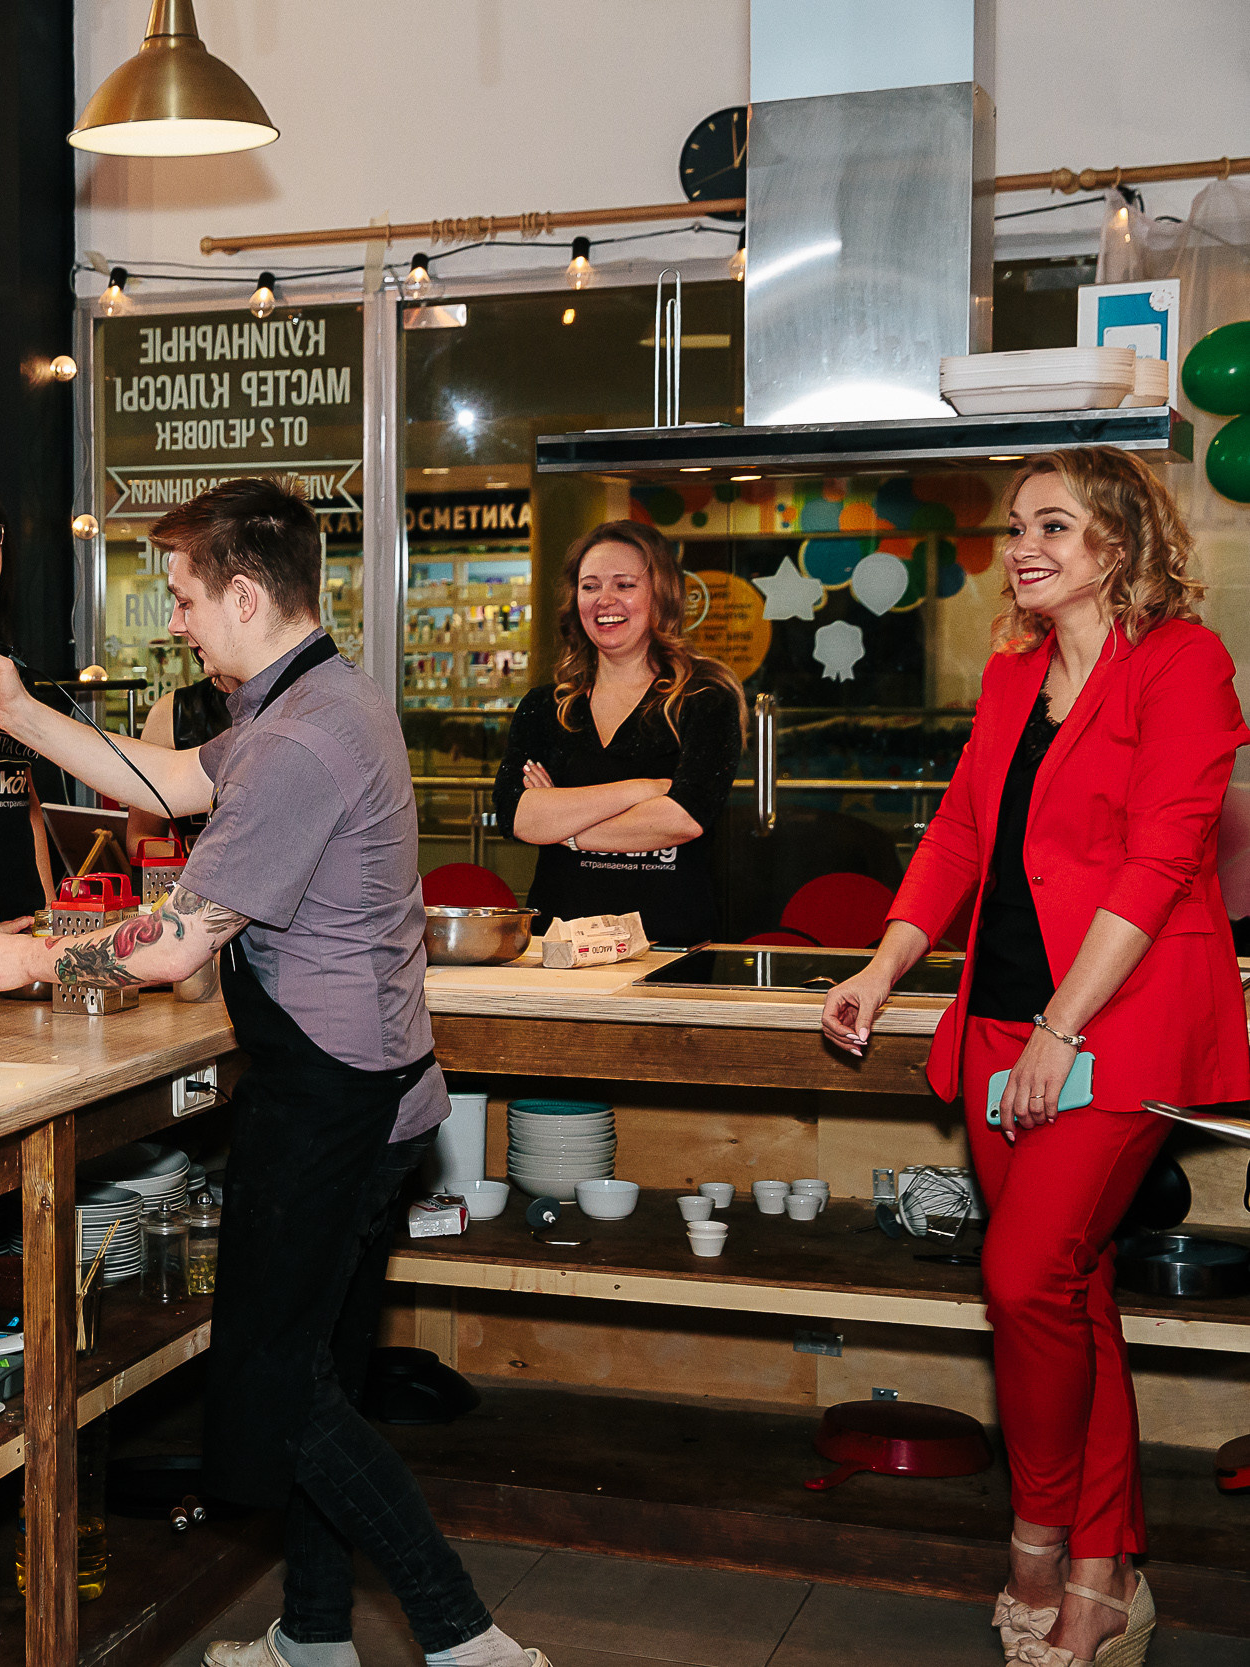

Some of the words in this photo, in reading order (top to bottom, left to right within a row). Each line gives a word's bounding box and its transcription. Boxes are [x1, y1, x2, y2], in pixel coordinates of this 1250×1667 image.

[405, 502, 532, 531] ОСМЕТИКА
[580, 860, 638, 871] встраиваемая
[641, 863, 676, 871] техника
